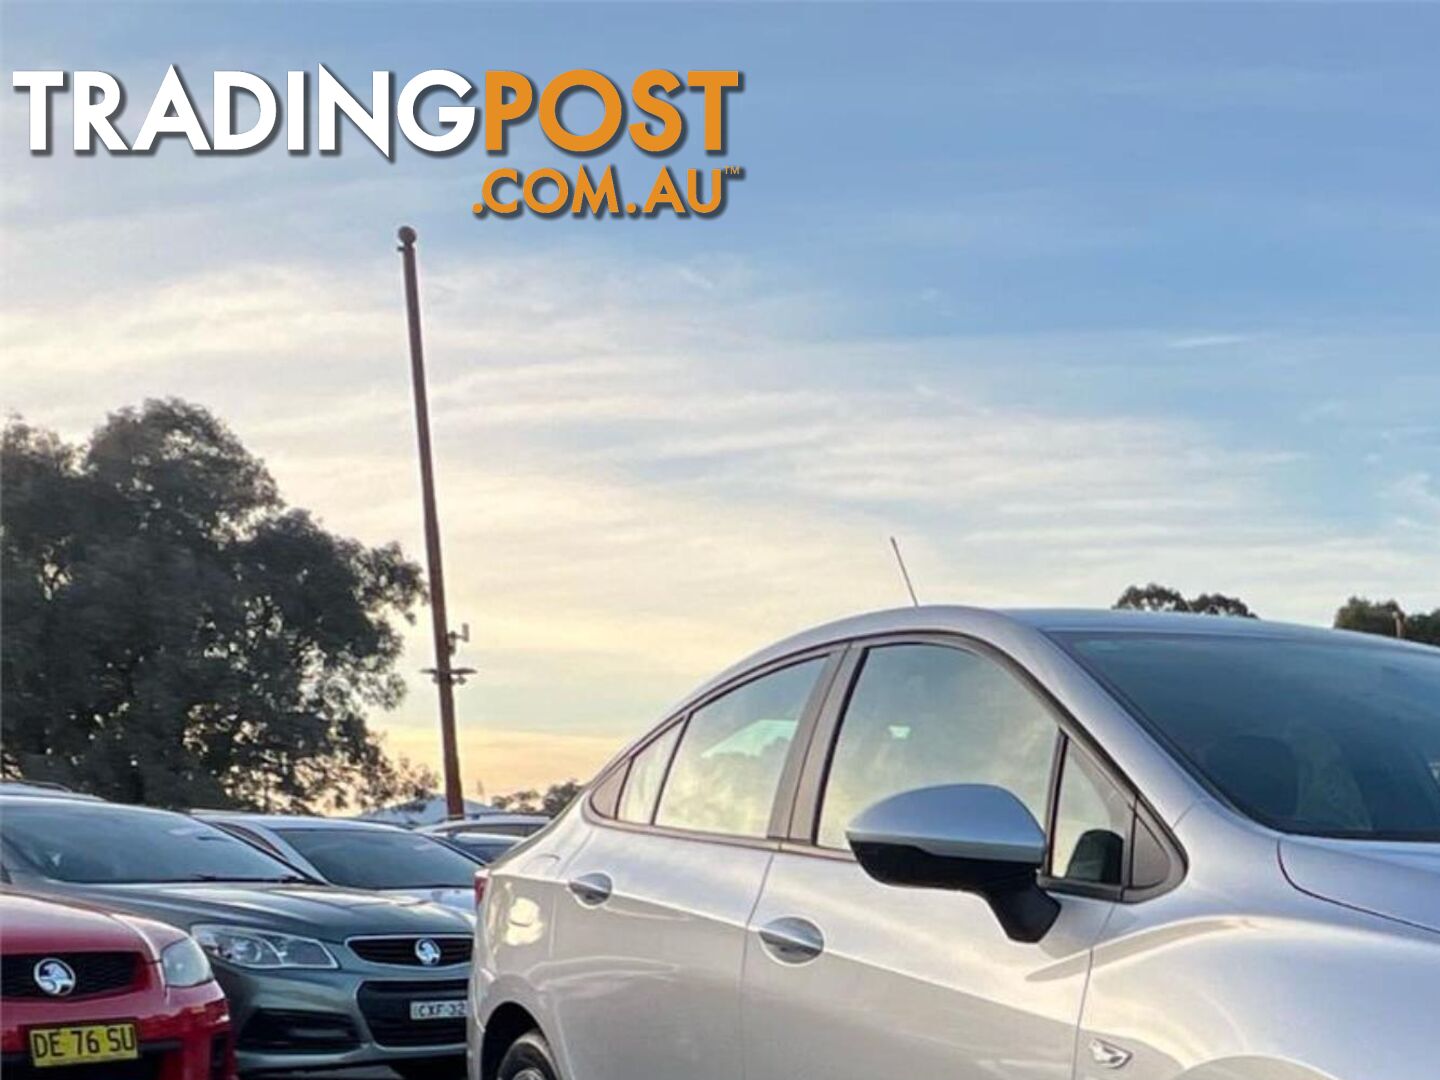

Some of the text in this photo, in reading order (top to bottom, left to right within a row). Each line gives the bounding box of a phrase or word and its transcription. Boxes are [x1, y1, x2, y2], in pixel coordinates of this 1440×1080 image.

[33, 1026, 135, 1058] DE 76 SU
